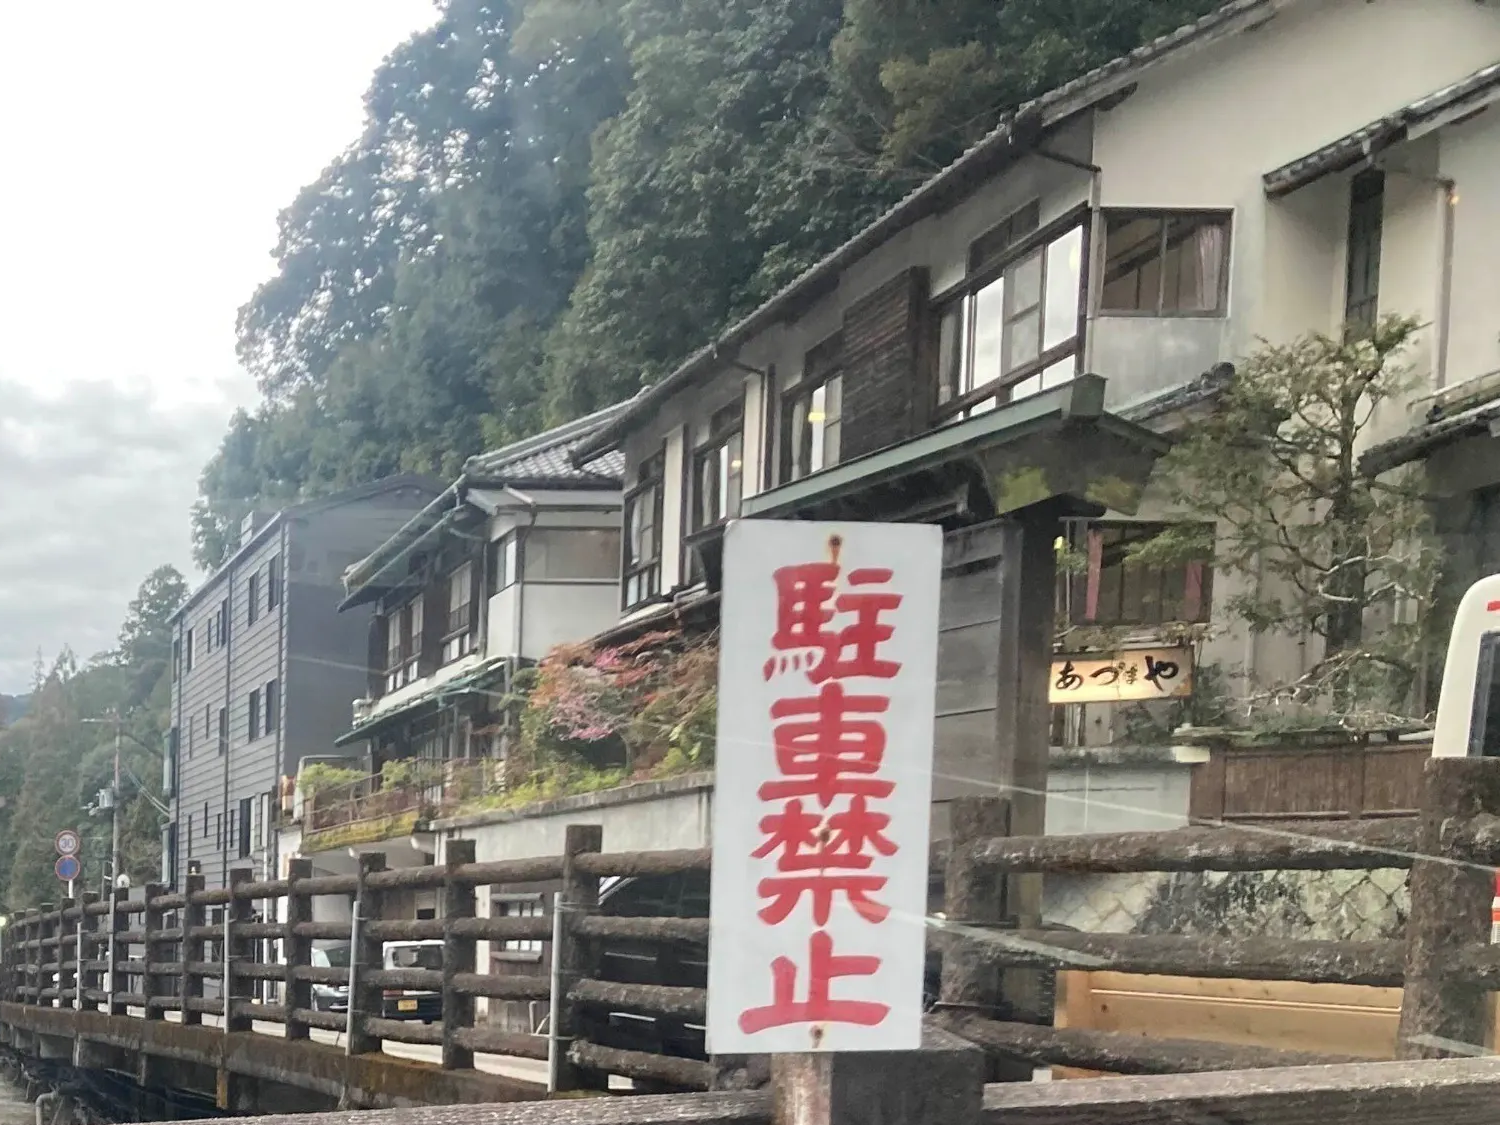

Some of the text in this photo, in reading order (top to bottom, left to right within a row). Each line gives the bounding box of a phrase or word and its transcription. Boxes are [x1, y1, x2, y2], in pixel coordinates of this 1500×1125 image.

[60, 838, 76, 849] 30
[738, 562, 903, 1035] 駐車禁止
